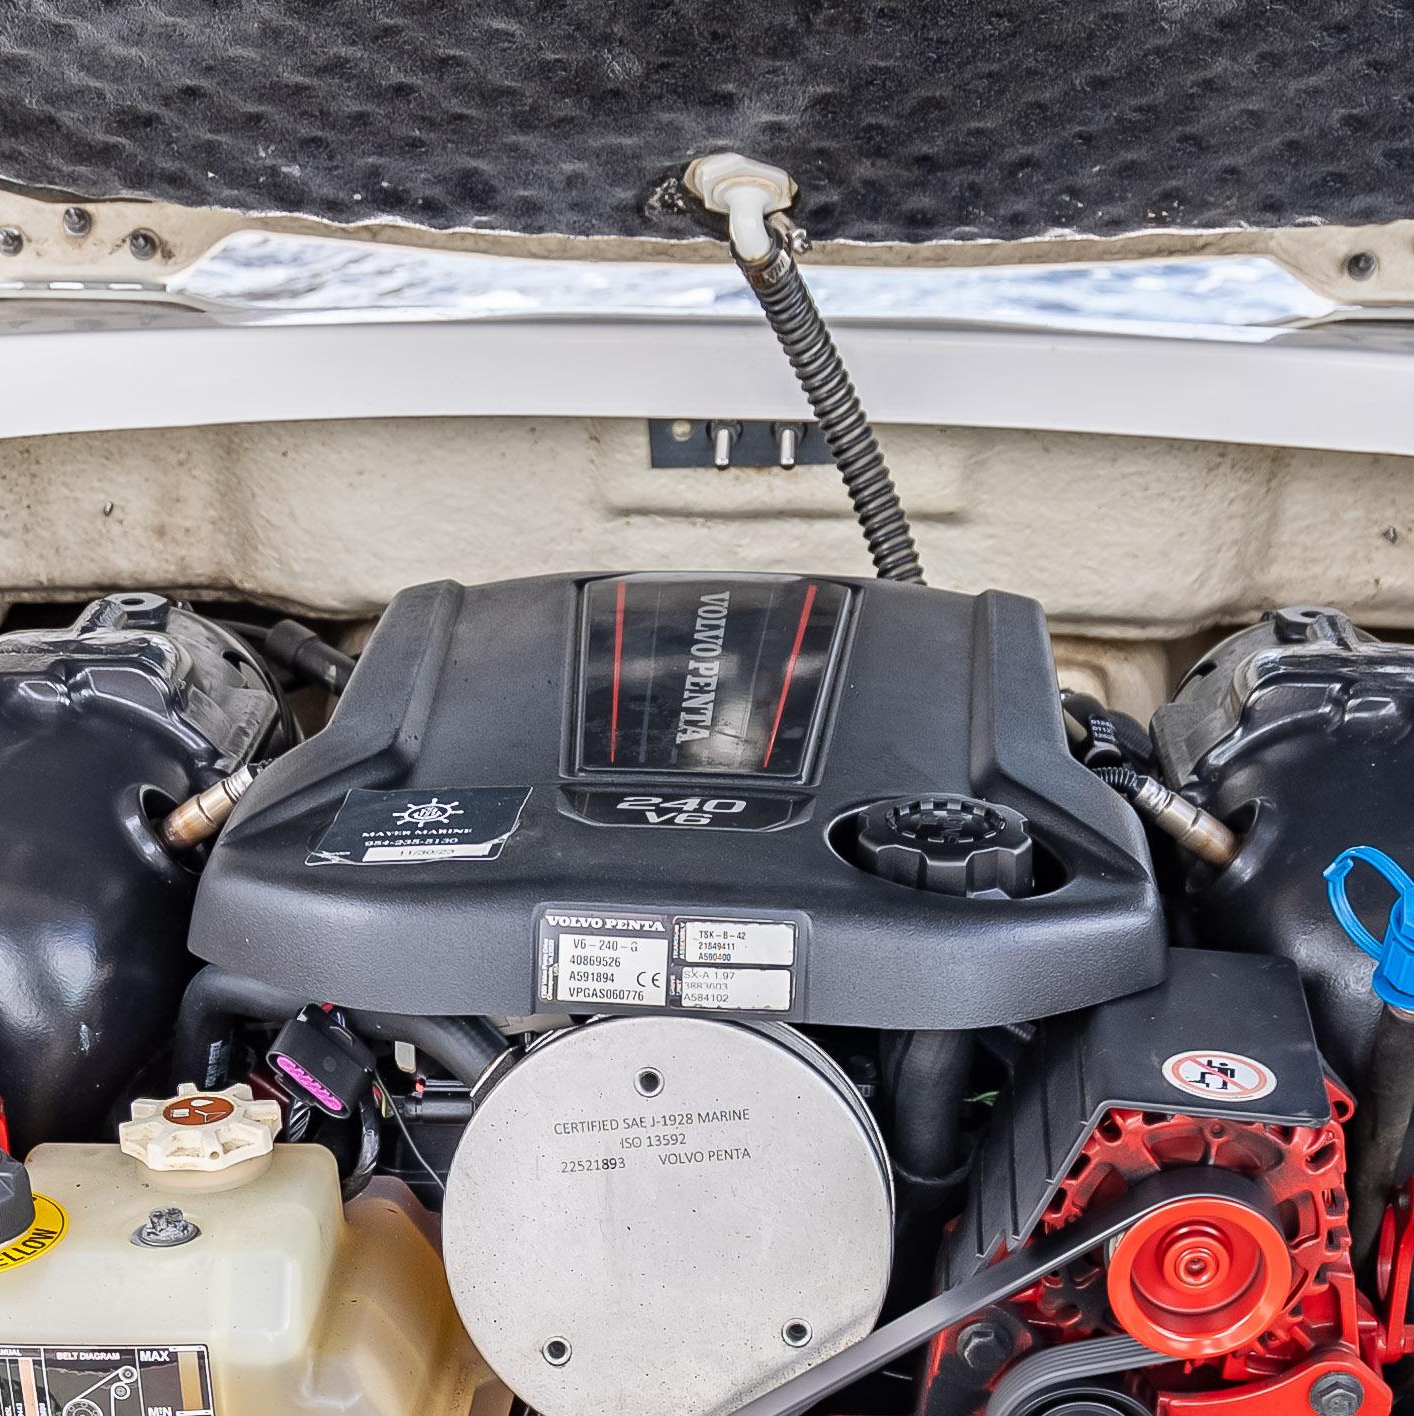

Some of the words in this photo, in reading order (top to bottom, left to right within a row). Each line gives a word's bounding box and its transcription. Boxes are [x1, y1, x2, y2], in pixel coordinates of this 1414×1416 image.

[690, 591, 730, 658] VOLVO
[676, 660, 720, 744] PENTA
[617, 797, 747, 812] 240
[645, 811, 713, 825] V6
[415, 828, 473, 836] MARINE
[545, 915, 603, 928] VOLVO
[605, 918, 666, 931] PENTA
[570, 955, 621, 967] 40869526
[569, 970, 615, 983] A591894
[569, 987, 644, 1001] VPGAS060776
[683, 993, 729, 1002] A584102
[554, 1118, 619, 1135] CERTIFIED
[623, 1116, 647, 1130] SAE
[651, 1113, 694, 1128] J-1928
[698, 1108, 750, 1124] MARINE
[621, 1136, 642, 1149] ISO
[646, 1133, 687, 1148] 13592
[561, 1157, 626, 1174] 22521893
[658, 1150, 704, 1166] VOLVO
[708, 1147, 751, 1162] PENTA
[56, 1352, 78, 1361] BELT
[79, 1352, 120, 1361] DIAGRAM
[140, 1351, 170, 1362] MAX
